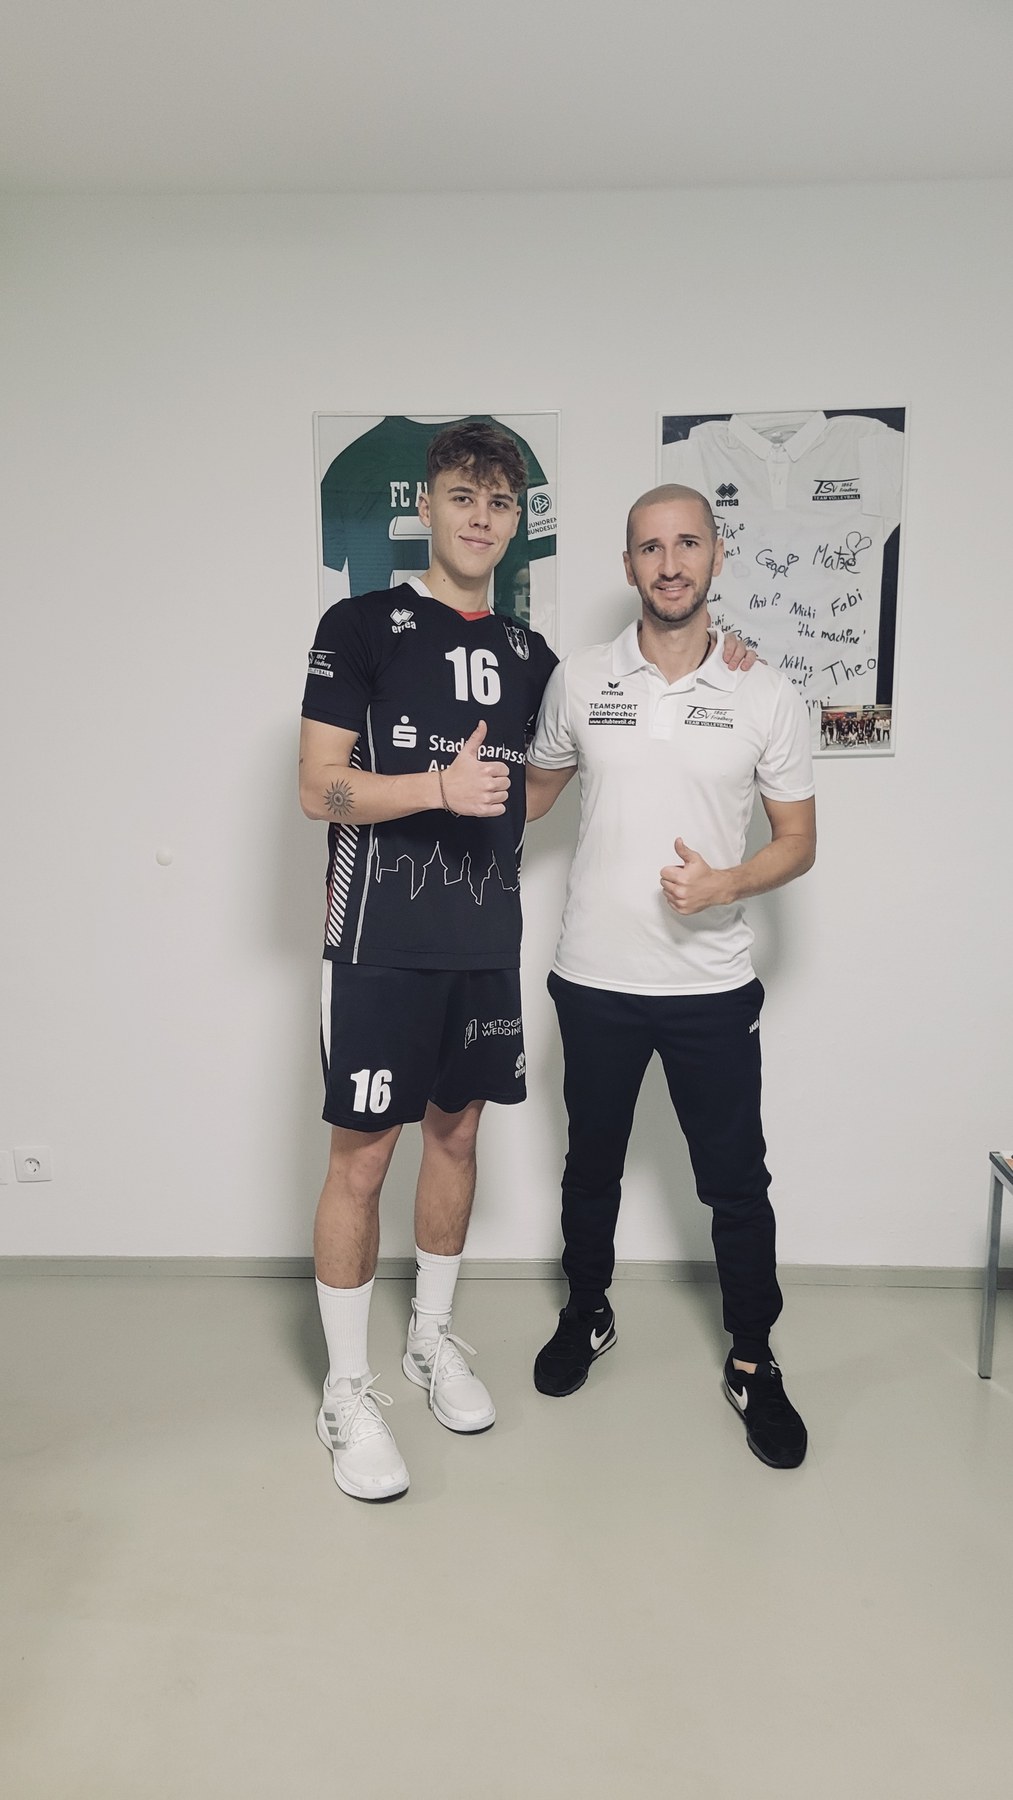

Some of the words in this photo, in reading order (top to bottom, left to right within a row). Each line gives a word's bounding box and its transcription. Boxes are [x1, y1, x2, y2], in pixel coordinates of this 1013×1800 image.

[390, 481, 410, 507] FC
[715, 499, 739, 507] errea
[789, 602, 816, 619] Michi
[831, 588, 863, 617] Fabi
[391, 621, 417, 634] errea
[445, 646, 501, 705] 16
[822, 658, 877, 686] Theo
[601, 689, 624, 697] erima
[350, 1068, 392, 1114] 16
